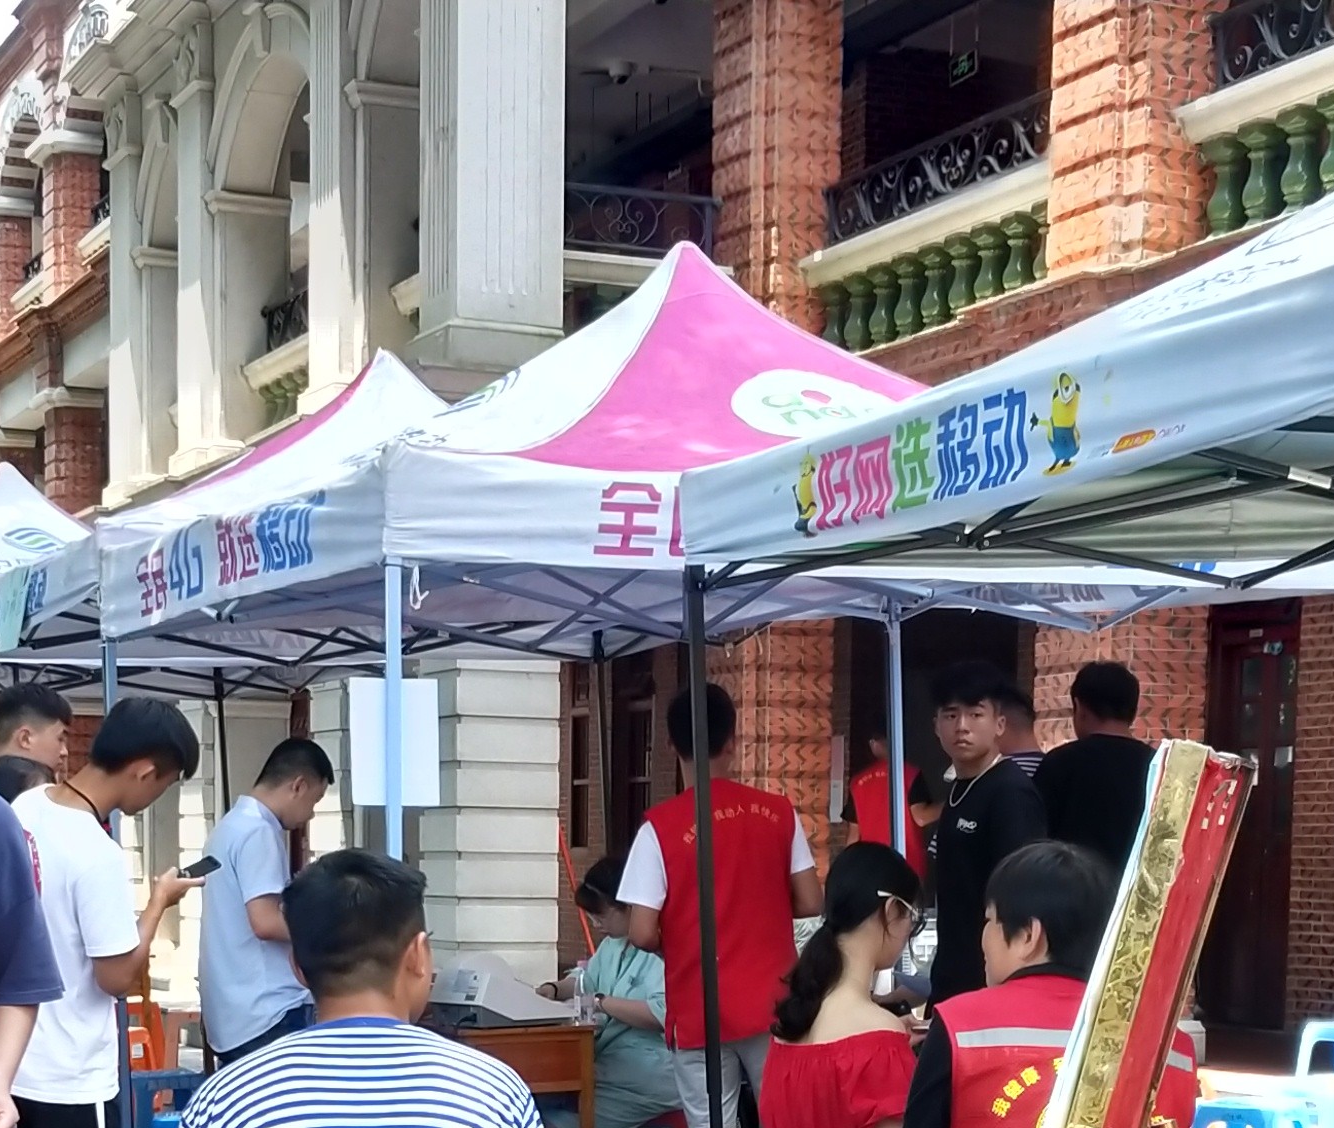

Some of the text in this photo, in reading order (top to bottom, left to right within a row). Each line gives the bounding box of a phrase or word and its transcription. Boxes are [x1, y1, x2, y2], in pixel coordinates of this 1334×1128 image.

[816, 387, 1029, 531] 好网选移动
[593, 481, 685, 557] 全
